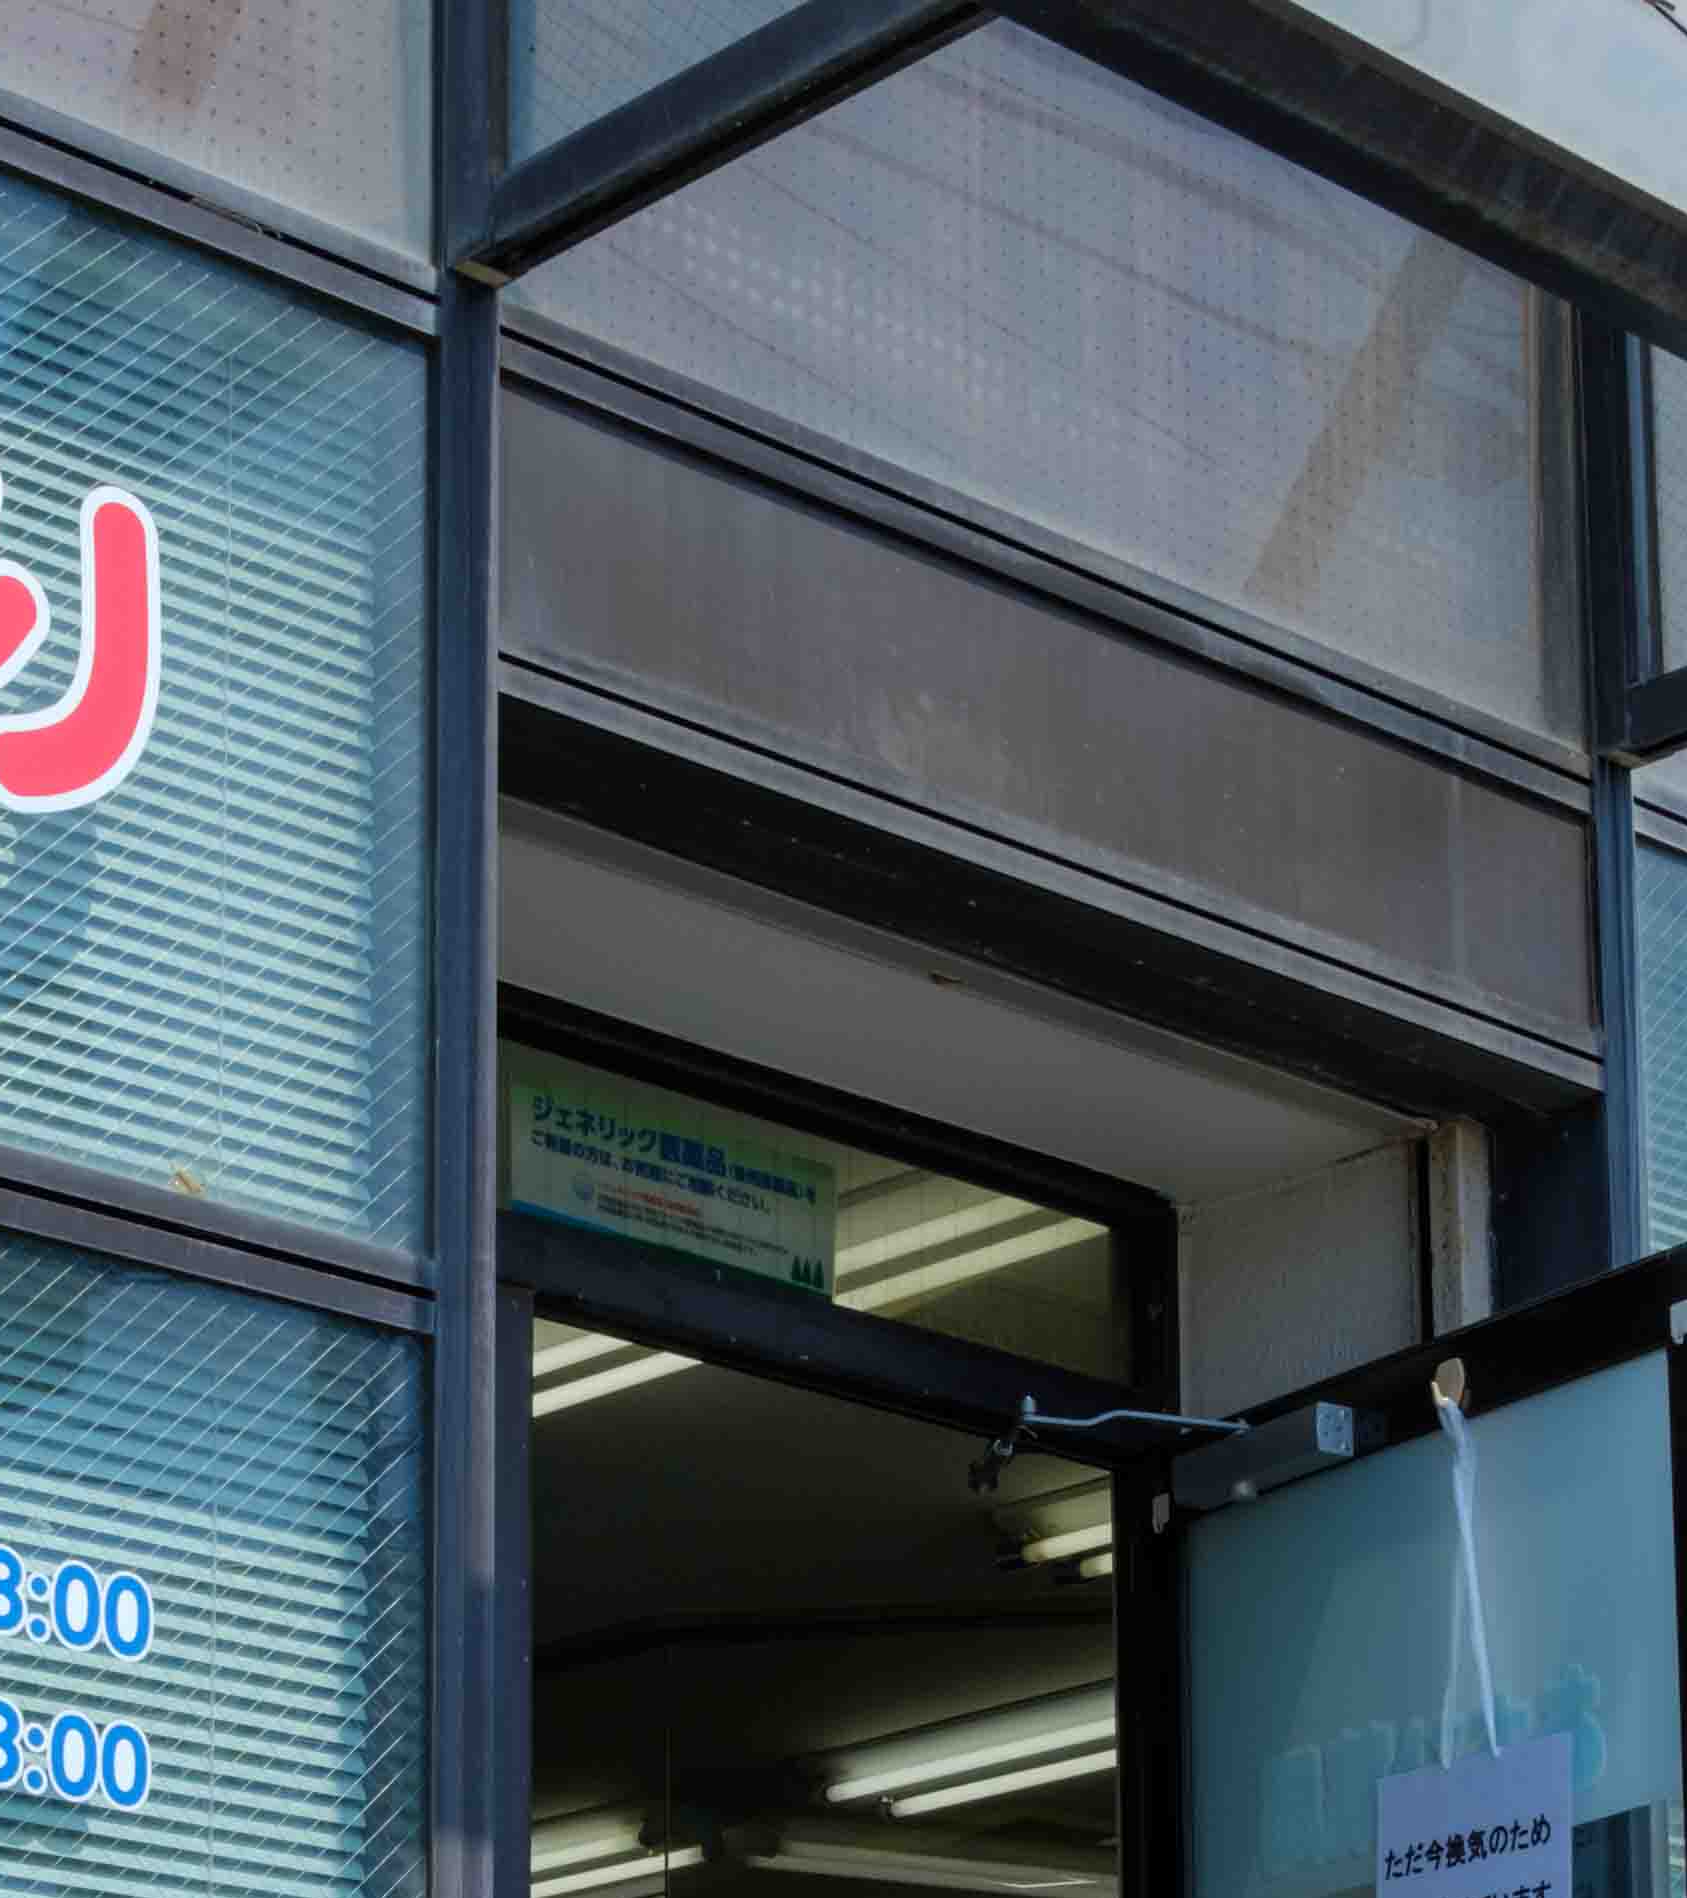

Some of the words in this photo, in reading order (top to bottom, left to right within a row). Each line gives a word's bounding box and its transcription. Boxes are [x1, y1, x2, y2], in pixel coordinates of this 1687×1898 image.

[1383, 1813, 1552, 1881] ただ今換気のため
